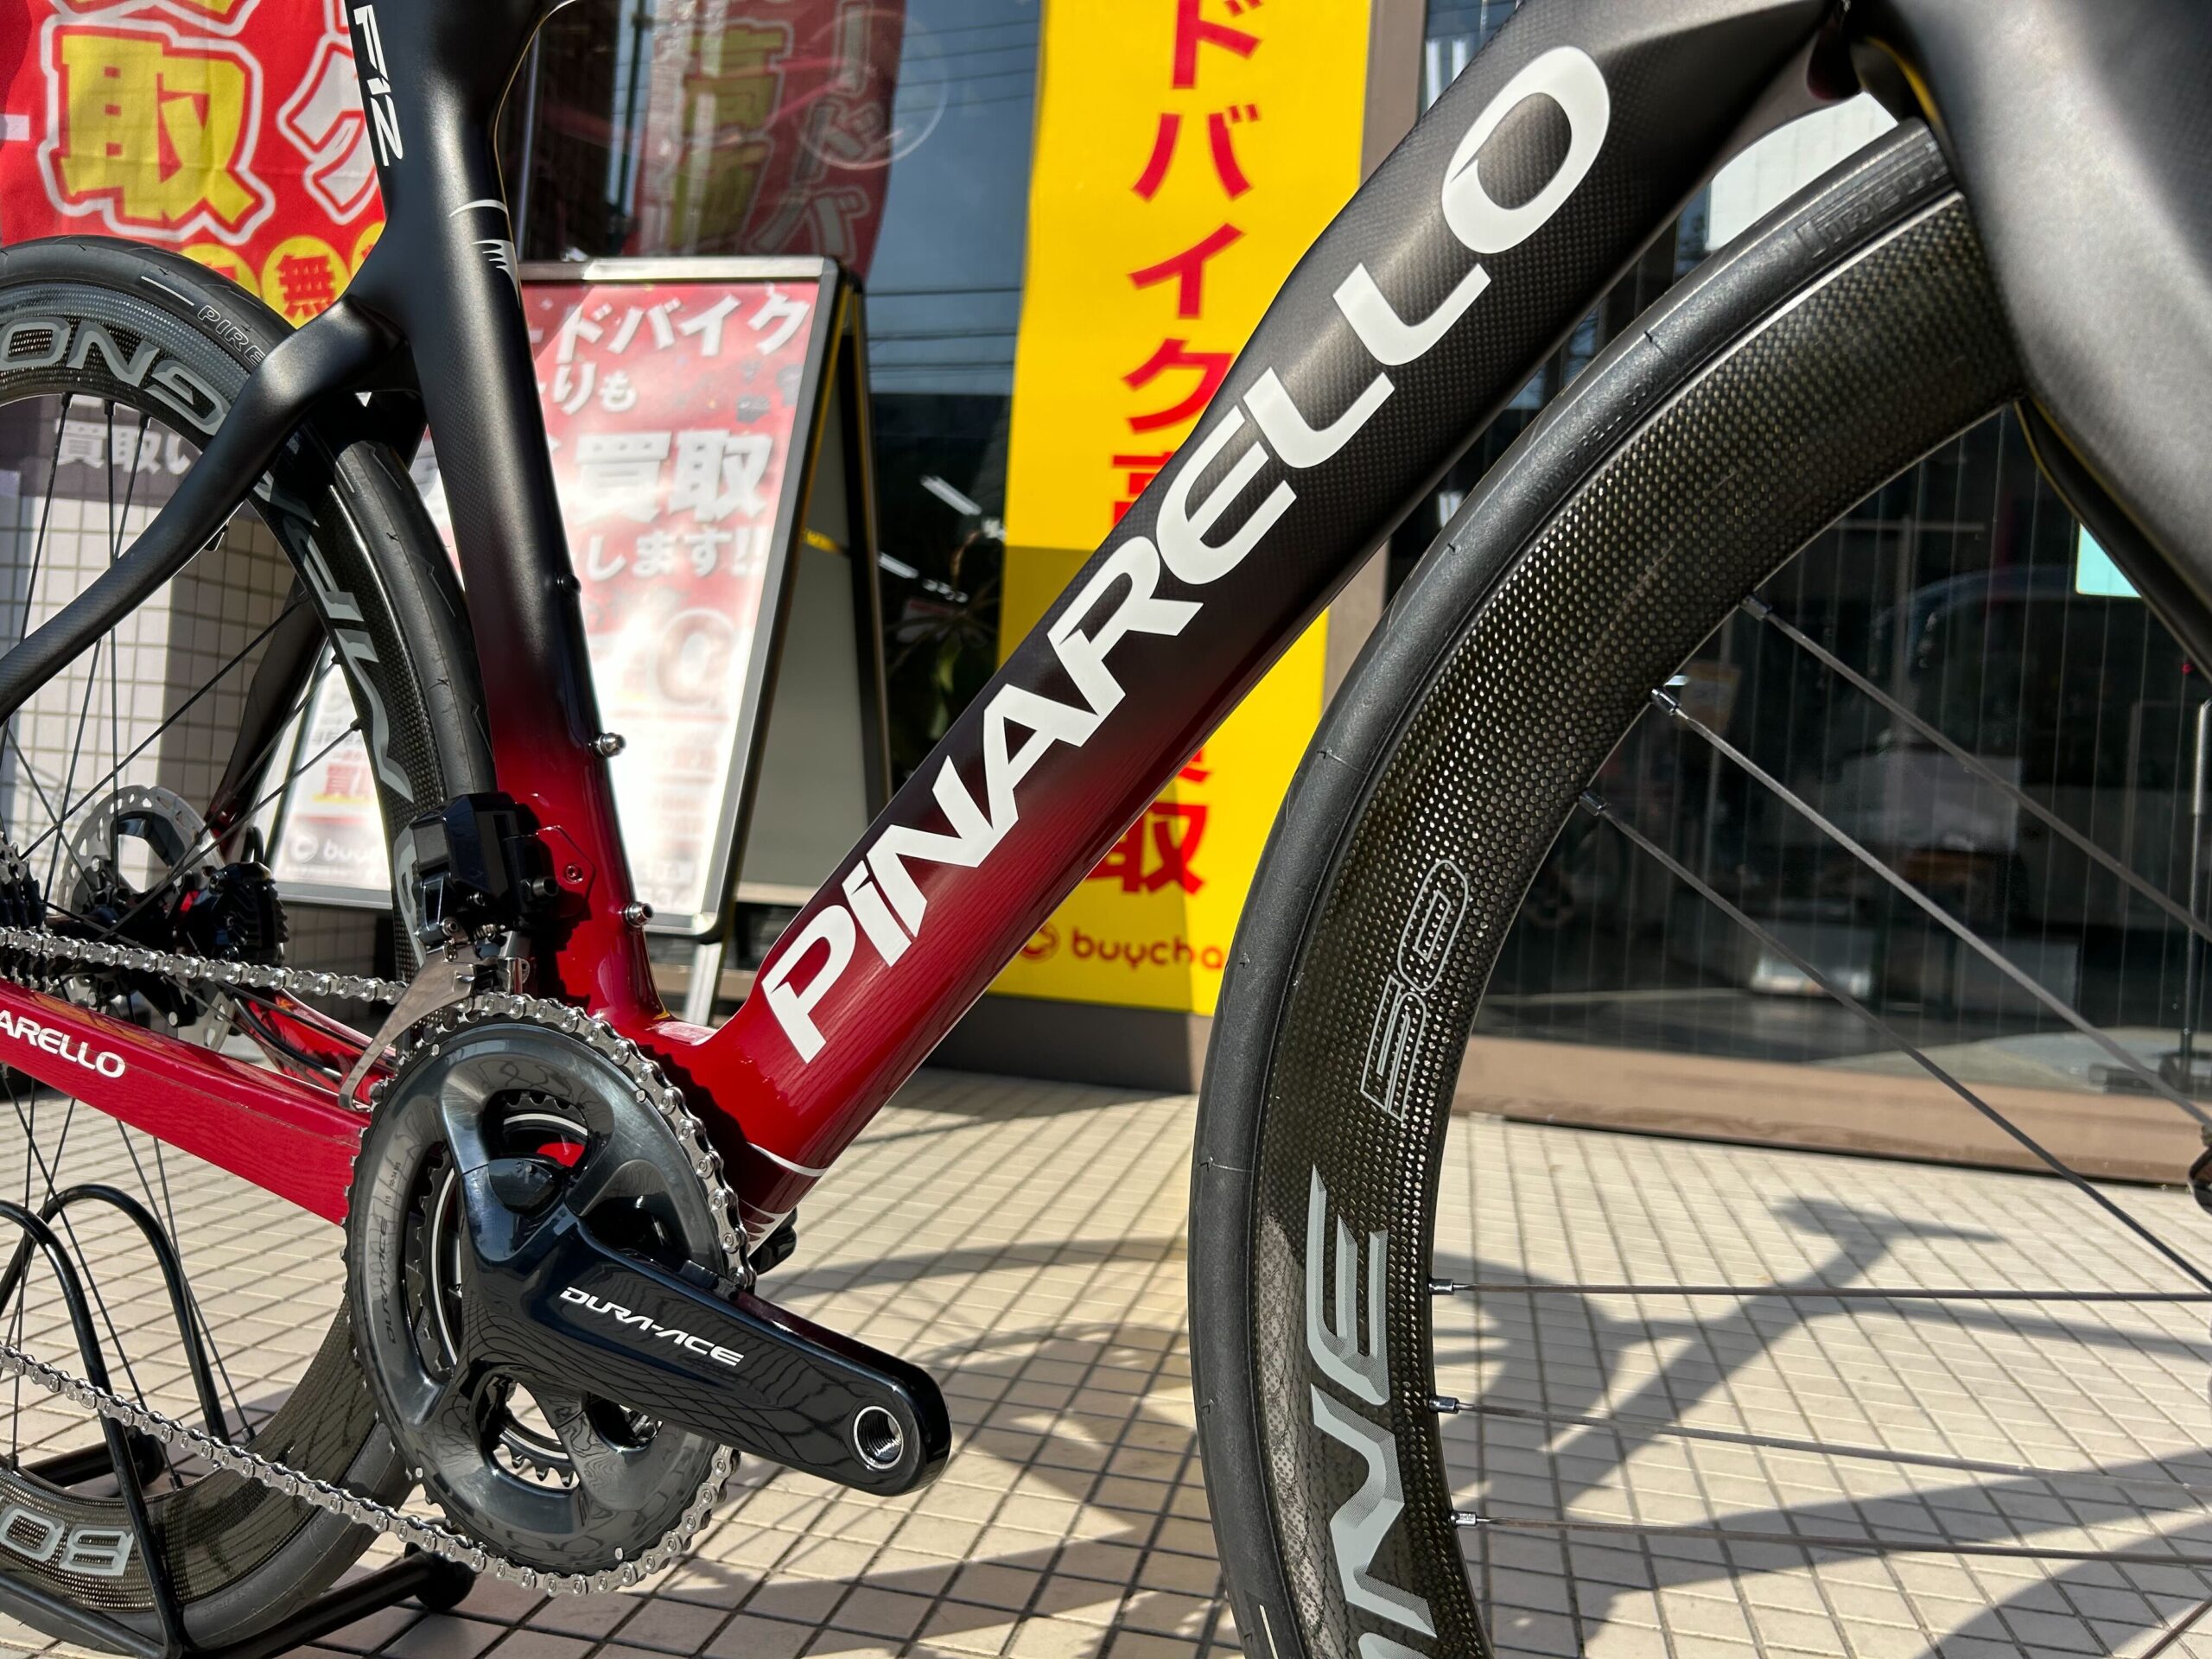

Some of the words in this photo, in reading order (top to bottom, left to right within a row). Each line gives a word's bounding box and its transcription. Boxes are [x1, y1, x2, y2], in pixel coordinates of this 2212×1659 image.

[60, 0, 257, 224] 取
[529, 291, 810, 364] ドバイク
[538, 361, 638, 416] りも
[548, 429, 774, 524] 買取
[559, 1286, 745, 1367] DURA-ACE
[1306, 1163, 1439, 1659] NE
